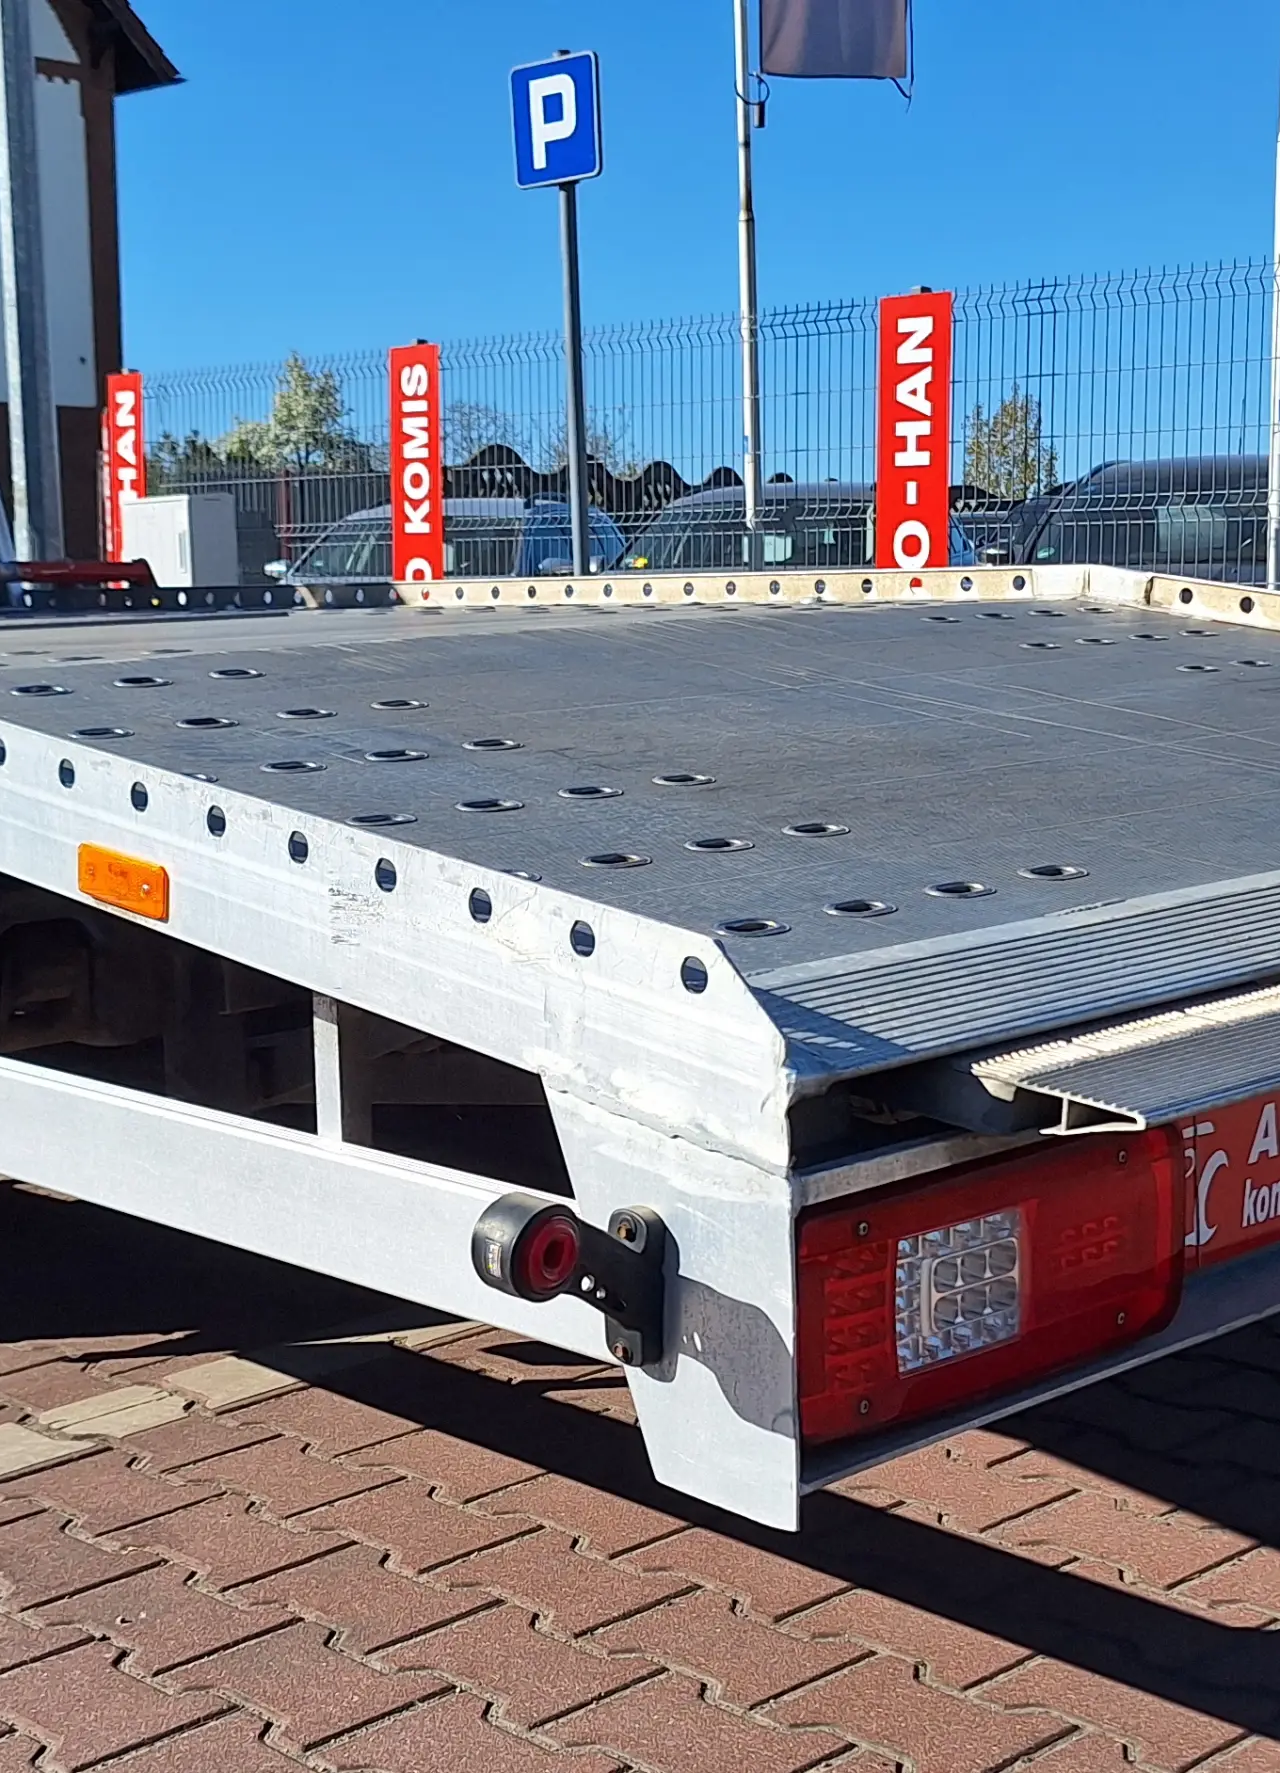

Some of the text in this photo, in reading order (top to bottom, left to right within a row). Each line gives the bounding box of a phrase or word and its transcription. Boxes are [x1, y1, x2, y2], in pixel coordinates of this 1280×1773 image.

[528, 73, 577, 170] P
[115, 390, 138, 501] HAN
[400, 363, 431, 534] KOMIS
